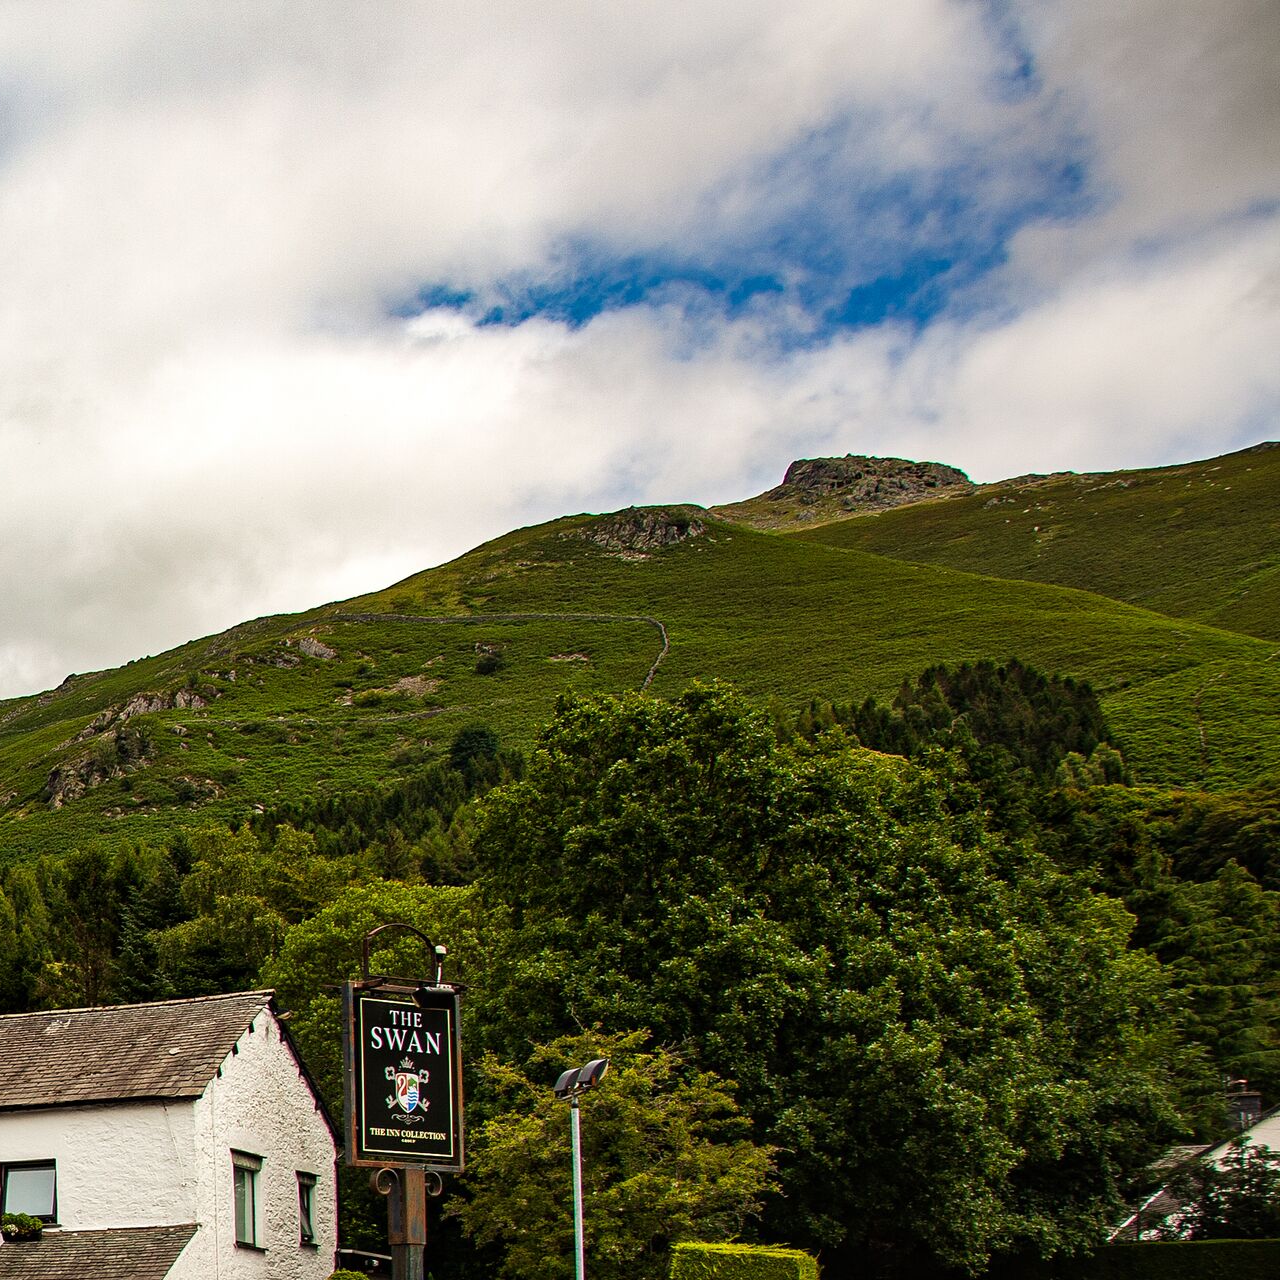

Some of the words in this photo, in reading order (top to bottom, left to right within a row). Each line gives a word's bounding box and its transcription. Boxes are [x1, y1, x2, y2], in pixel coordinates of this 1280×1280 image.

[389, 1010, 423, 1028] THE
[371, 1026, 441, 1055] SWAN
[369, 1127, 386, 1136] THE
[386, 1128, 400, 1137] INN
[401, 1130, 447, 1140] COLLECTION
